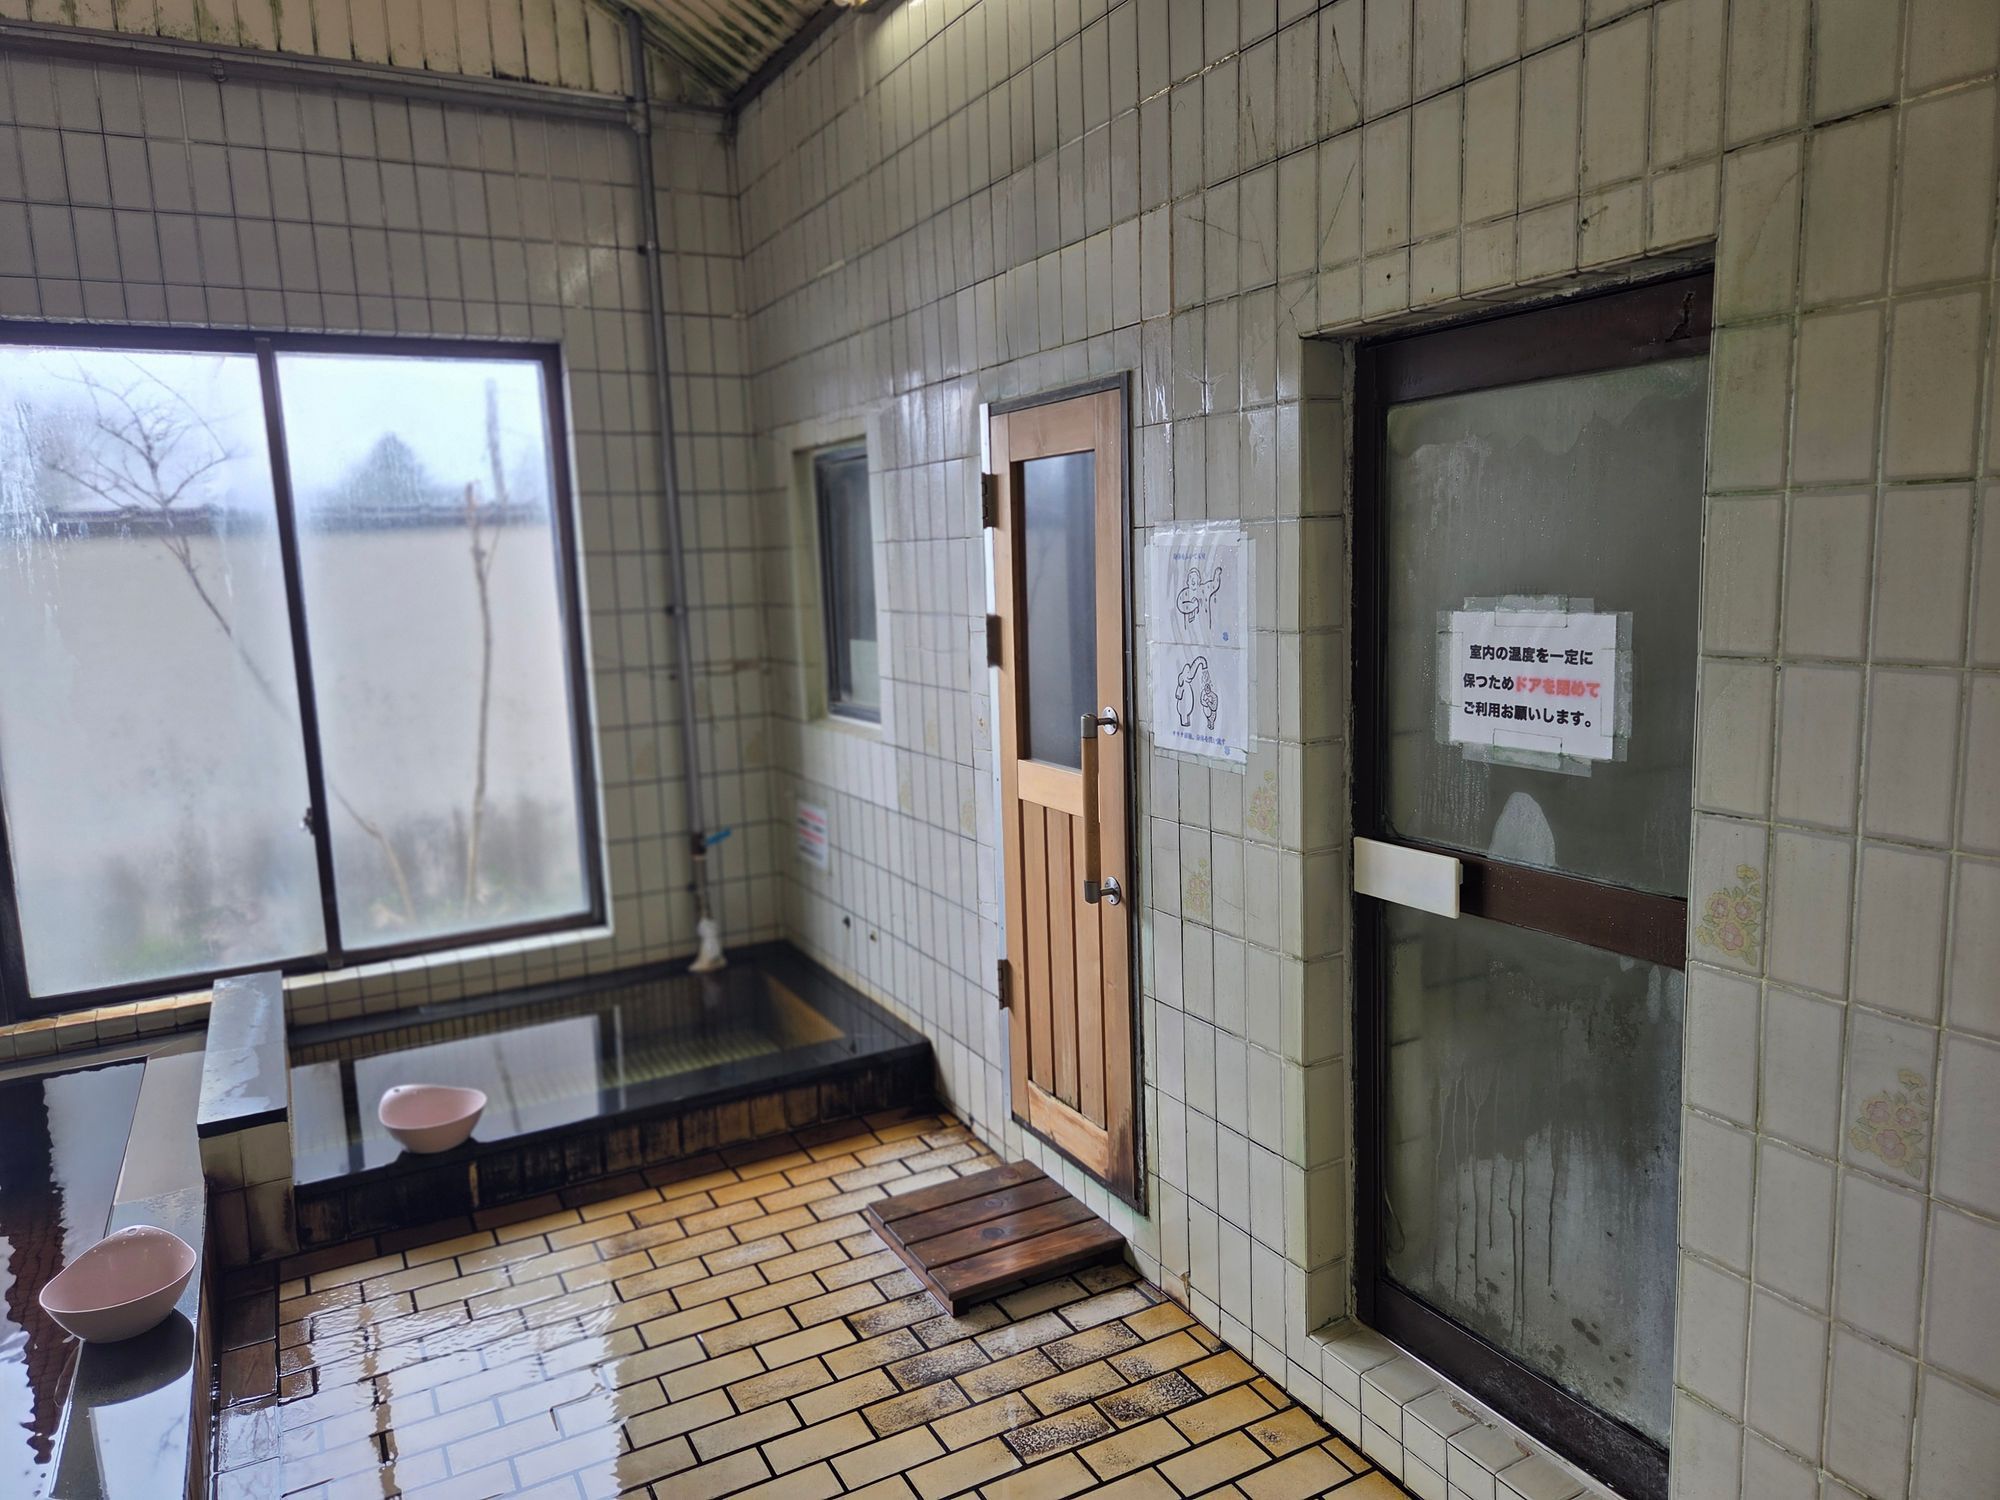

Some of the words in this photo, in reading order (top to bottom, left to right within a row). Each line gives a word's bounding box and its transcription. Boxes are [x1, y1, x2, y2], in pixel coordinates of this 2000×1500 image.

[1469, 644, 1593, 665] 室内の温度を一定に
[1464, 701, 1591, 727] ご利用お願いします。
